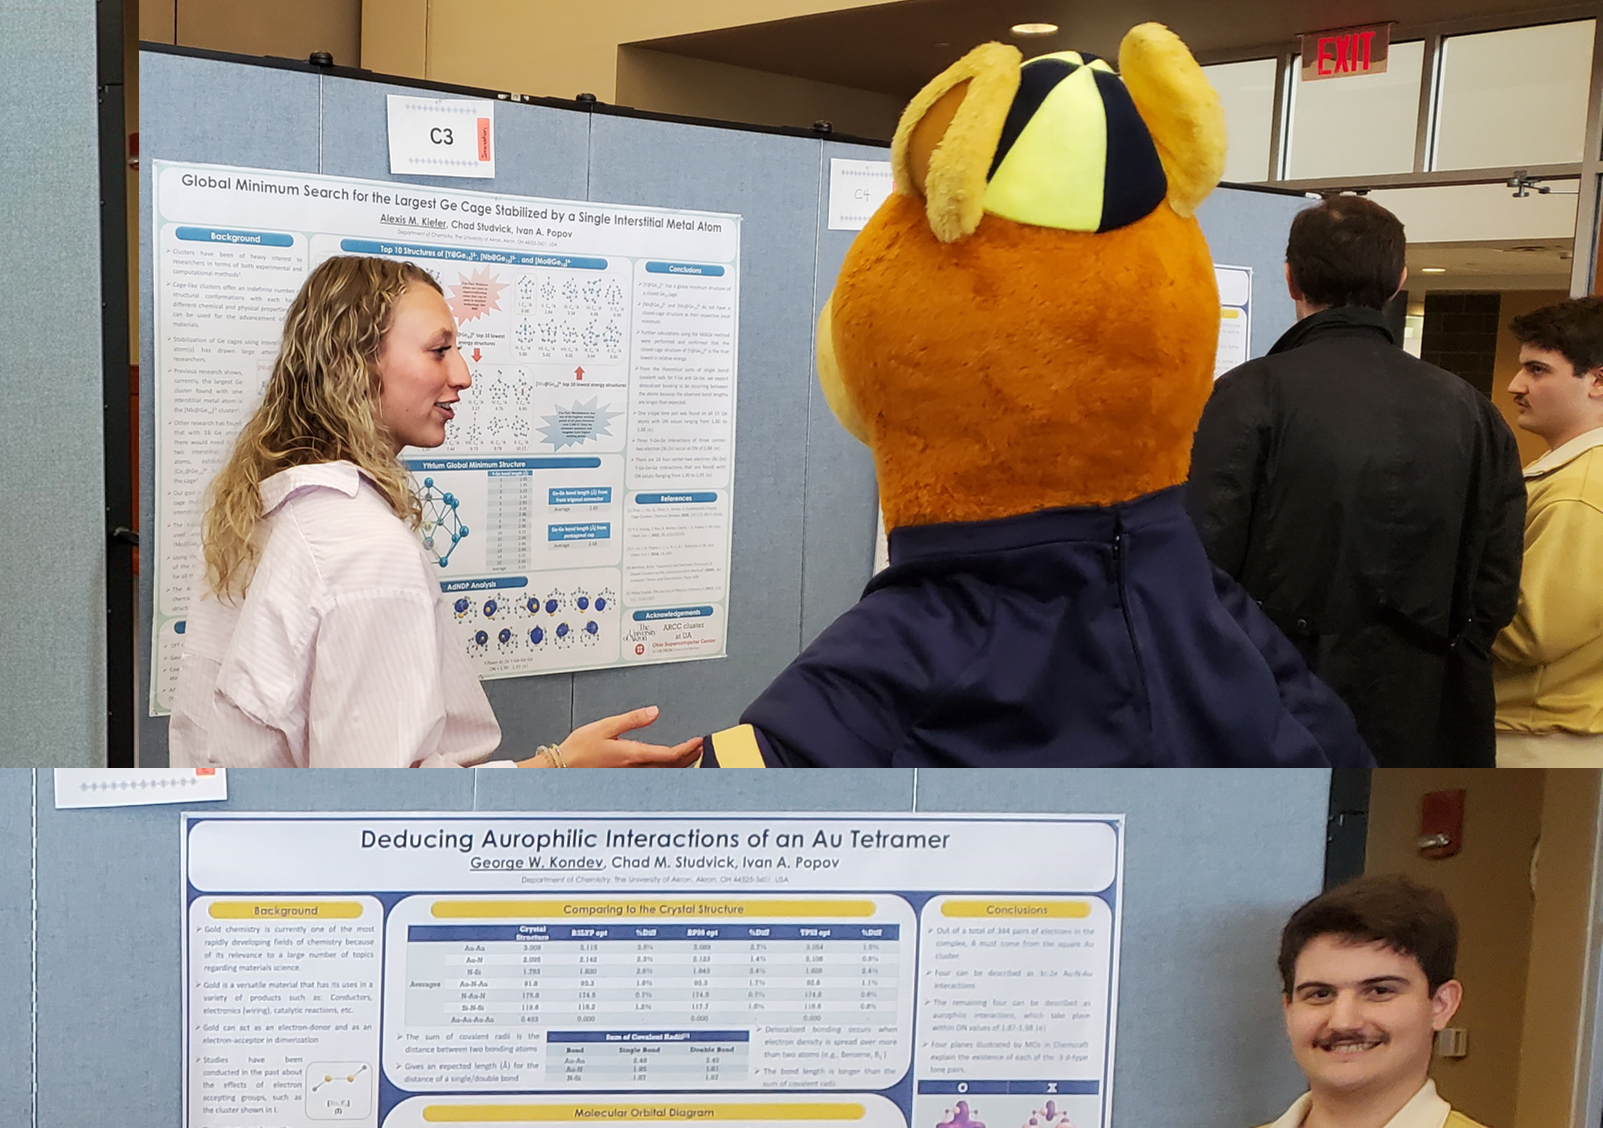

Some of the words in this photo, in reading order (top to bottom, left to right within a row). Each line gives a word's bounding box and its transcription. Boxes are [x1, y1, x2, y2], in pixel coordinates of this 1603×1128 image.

[1317, 30, 1377, 76] EXIT
[429, 127, 454, 146] C3
[853, 188, 871, 202] C4
[181, 174, 231, 189] Global
[235, 179, 300, 195] Minimum
[303, 184, 349, 200] Search
[352, 189, 369, 202] for
[371, 191, 392, 205] the
[395, 194, 437, 210] Largest
[439, 198, 458, 211] Ge
[460, 200, 493, 217] Cage
[495, 203, 548, 219] Stabilized
[551, 209, 566, 223] by
[567, 213, 576, 222] a
[578, 211, 611, 226] Single
[614, 215, 665, 228] Interstitial
[666, 218, 695, 231] Metal
[697, 221, 722, 233] Atom
[210, 231, 261, 244] Background
[668, 265, 703, 275] Conclusions
[645, 610, 701, 620] Acknowledgements
[361, 829, 474, 853] Deducing
[481, 829, 598, 852] Aurophilic
[606, 829, 739, 848] Interactions
[747, 829, 770, 848] of
[775, 834, 804, 848] an
[811, 829, 843, 848] Au
[850, 829, 951, 849] Tetramer
[470, 856, 525, 872] George
[528, 856, 545, 872] W.
[549, 856, 607, 872] Kondev,
[611, 856, 651, 869] Chad
[653, 856, 671, 868] M.
[675, 856, 739, 869] Studvick,
[742, 856, 773, 869] Ivan
[776, 856, 791, 869] A.
[795, 856, 840, 871] Popov
[254, 906, 319, 918] Background
[563, 904, 624, 916] Comparing
[626, 904, 637, 914] to
[639, 904, 657, 914] the
[659, 904, 696, 916] Crystal
[698, 904, 745, 914] Structure
[986, 905, 1048, 915] Conclusions
[574, 1108, 628, 1118] Molecular
[630, 1108, 667, 1118] Orbital
[669, 1108, 715, 1119] Diagram
